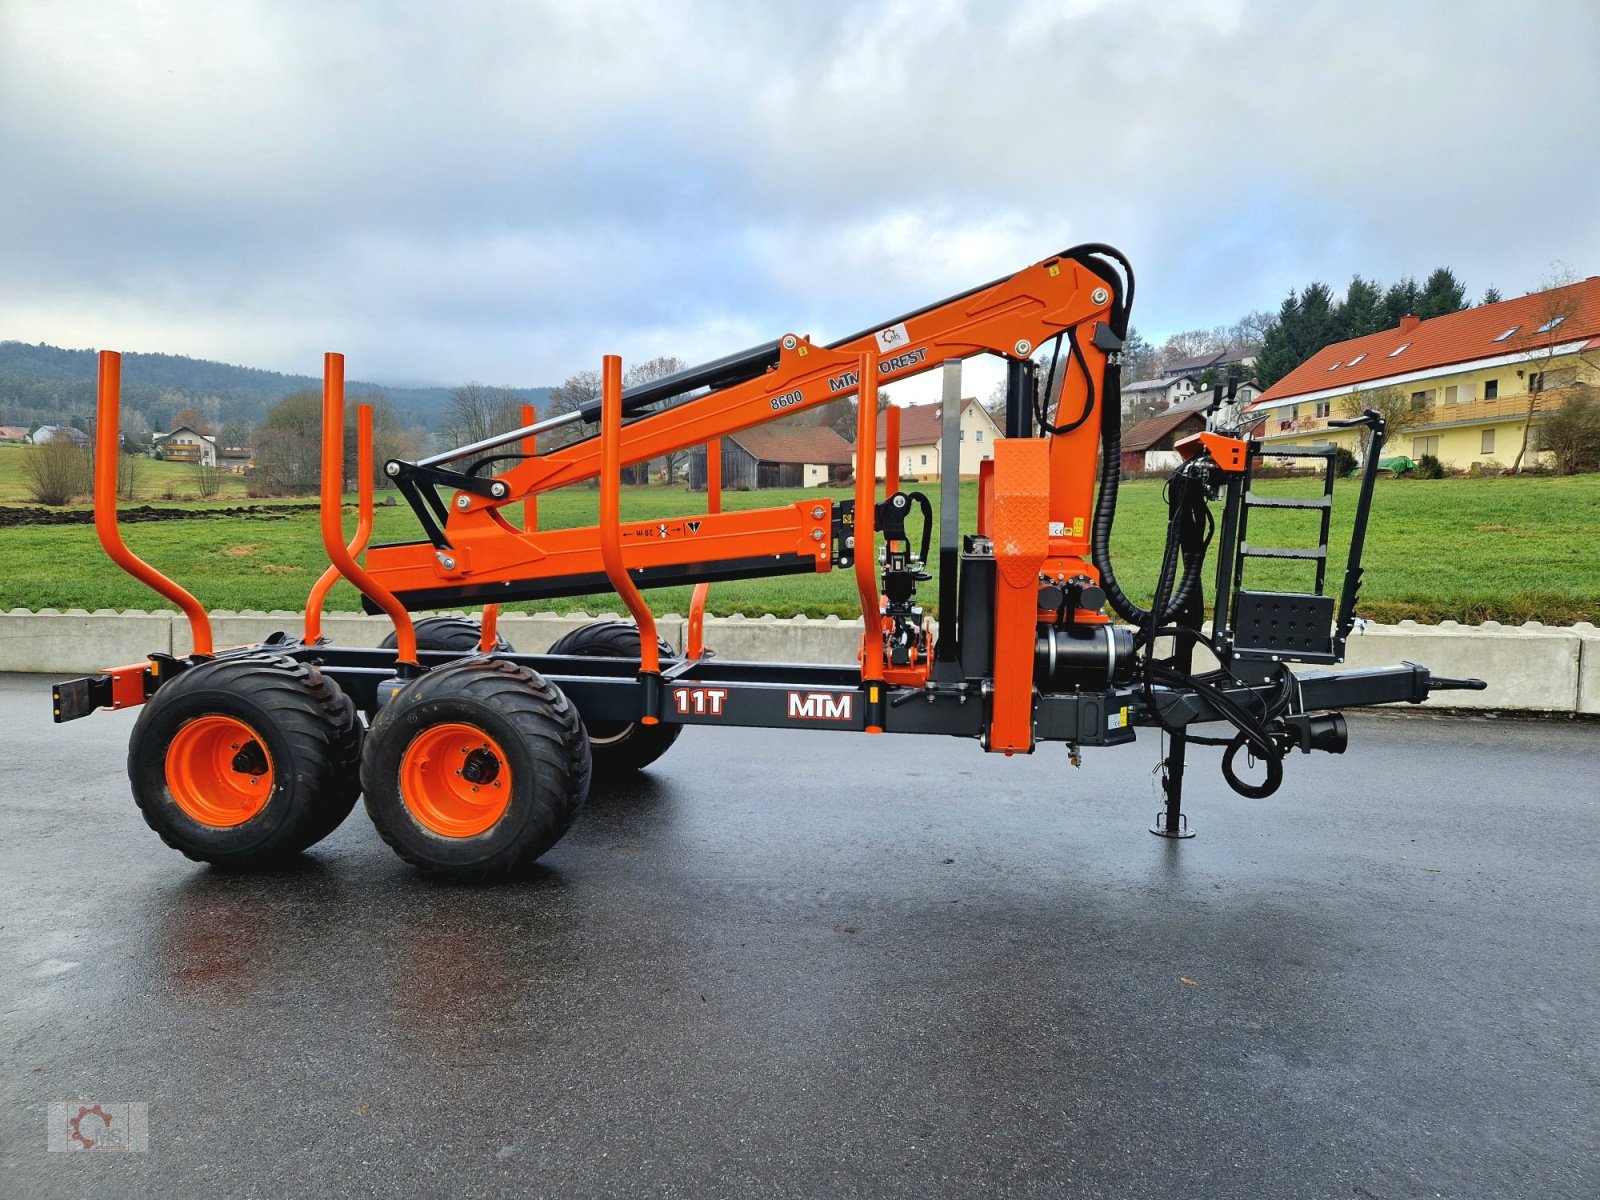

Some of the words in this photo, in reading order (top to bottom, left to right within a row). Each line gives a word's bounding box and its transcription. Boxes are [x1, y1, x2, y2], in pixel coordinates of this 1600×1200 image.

[878, 347, 928, 374] OREST
[770, 390, 803, 411] 8600
[674, 687, 727, 716] 11T
[787, 690, 852, 721] MTM
